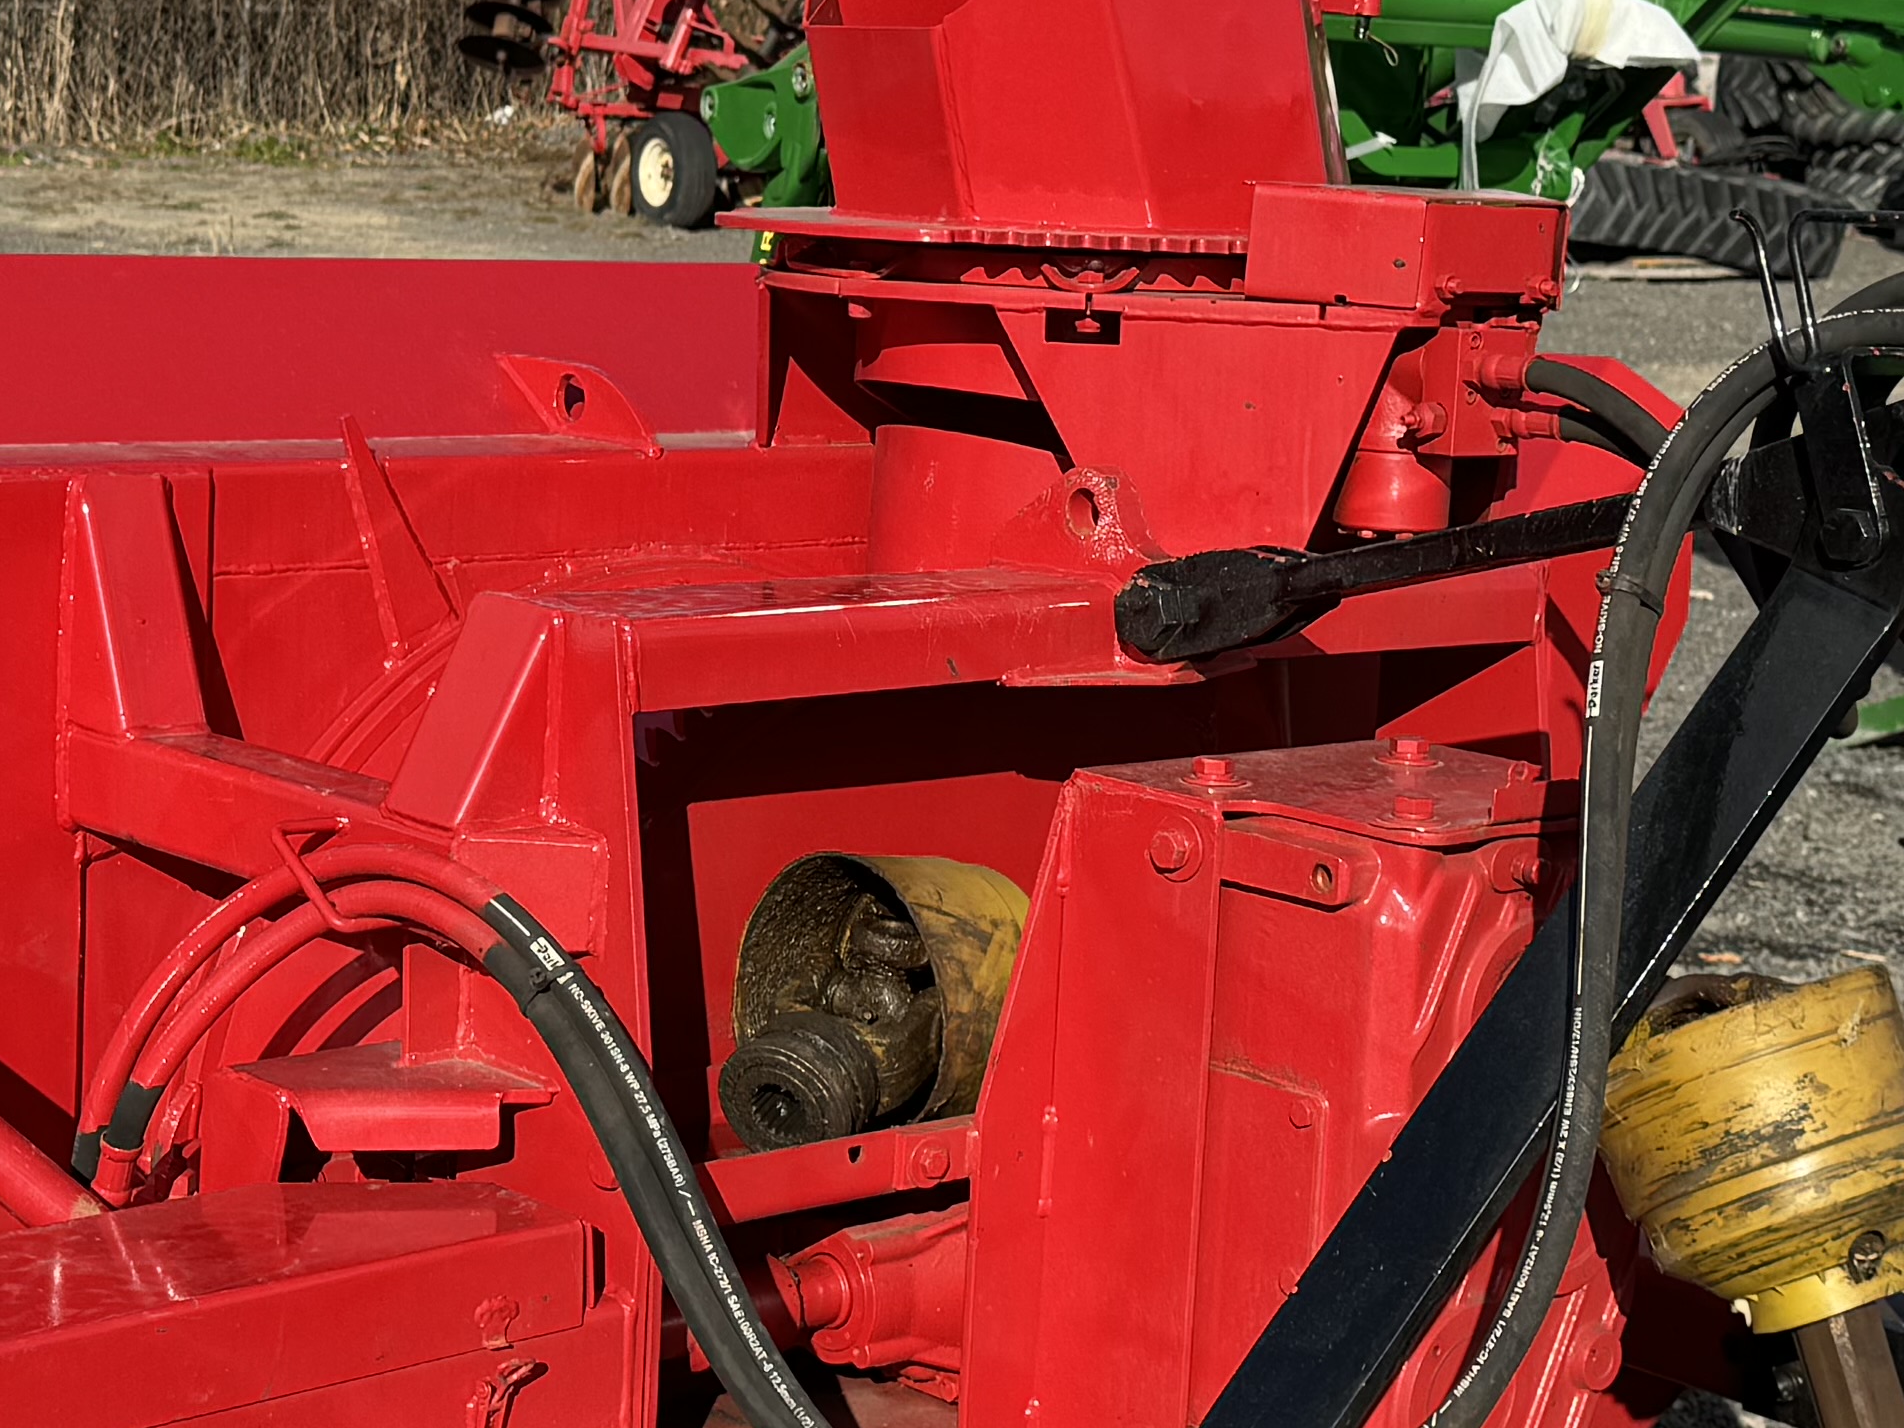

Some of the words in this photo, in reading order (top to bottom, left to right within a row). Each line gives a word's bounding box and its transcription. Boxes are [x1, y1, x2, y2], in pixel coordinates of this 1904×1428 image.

[1593, 595, 1611, 654] NO-SKIVE
[1587, 663, 1602, 710] Parker
[624, 1070, 641, 1091] WP
[633, 1090, 652, 1115] 27,5
[645, 1112, 662, 1139] MPa
[656, 1137, 686, 1188] (275BAR)
[691, 1218, 714, 1253] MSHA
